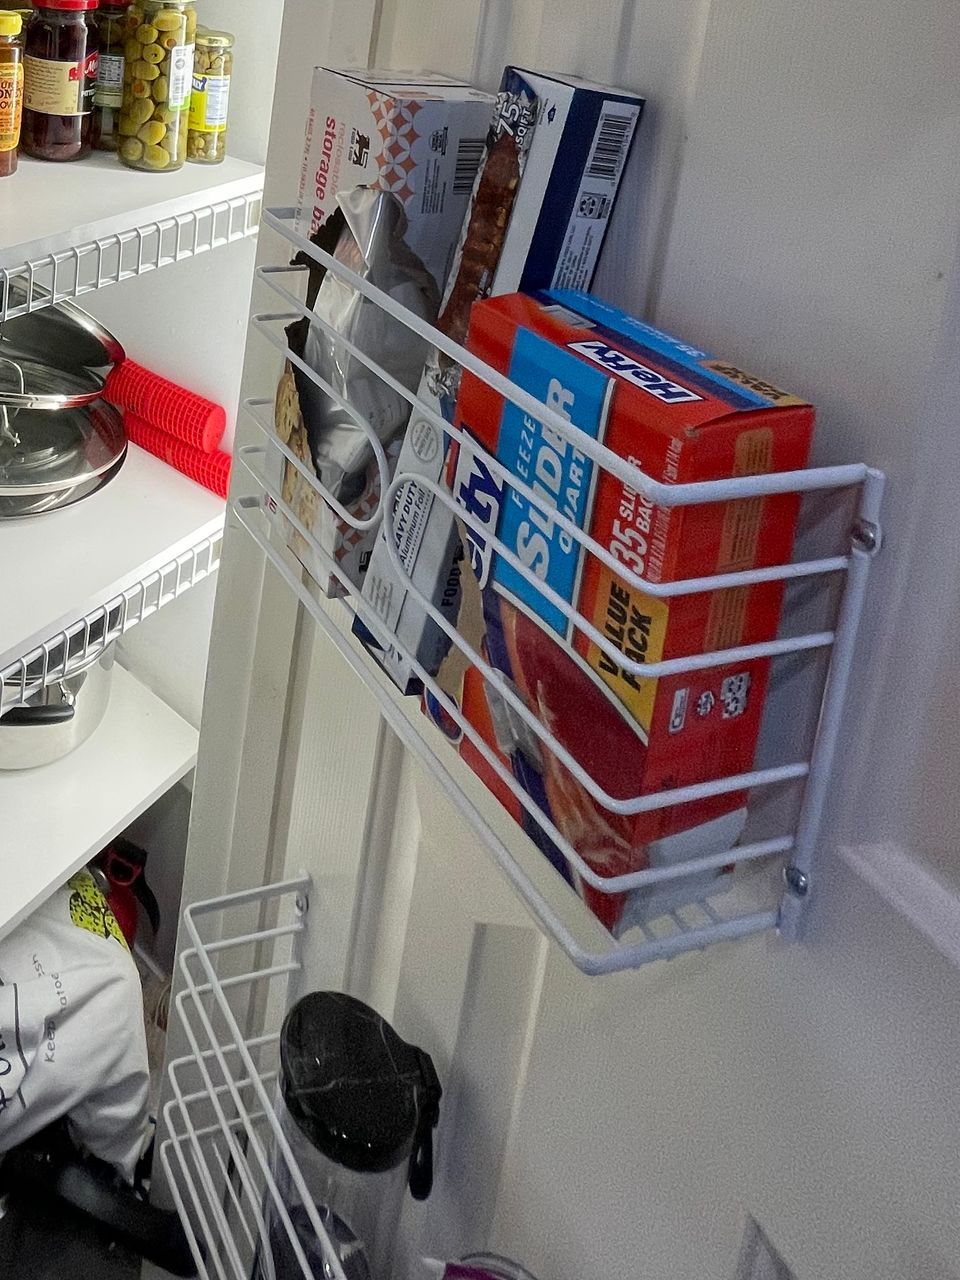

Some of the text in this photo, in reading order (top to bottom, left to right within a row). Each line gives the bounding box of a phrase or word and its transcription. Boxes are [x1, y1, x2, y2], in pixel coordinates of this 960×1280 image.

[497, 102, 519, 137] 75
[515, 109, 532, 144] SQ FT
[315, 116, 336, 201] storage
[331, 122, 346, 196] reclosable
[582, 344, 693, 401] Hefty
[394, 481, 419, 551] EAVY DUTY
[400, 489, 426, 563] Aluminum Foil
[610, 520, 648, 577] 35
[44, 1020, 56, 1063] Keep
